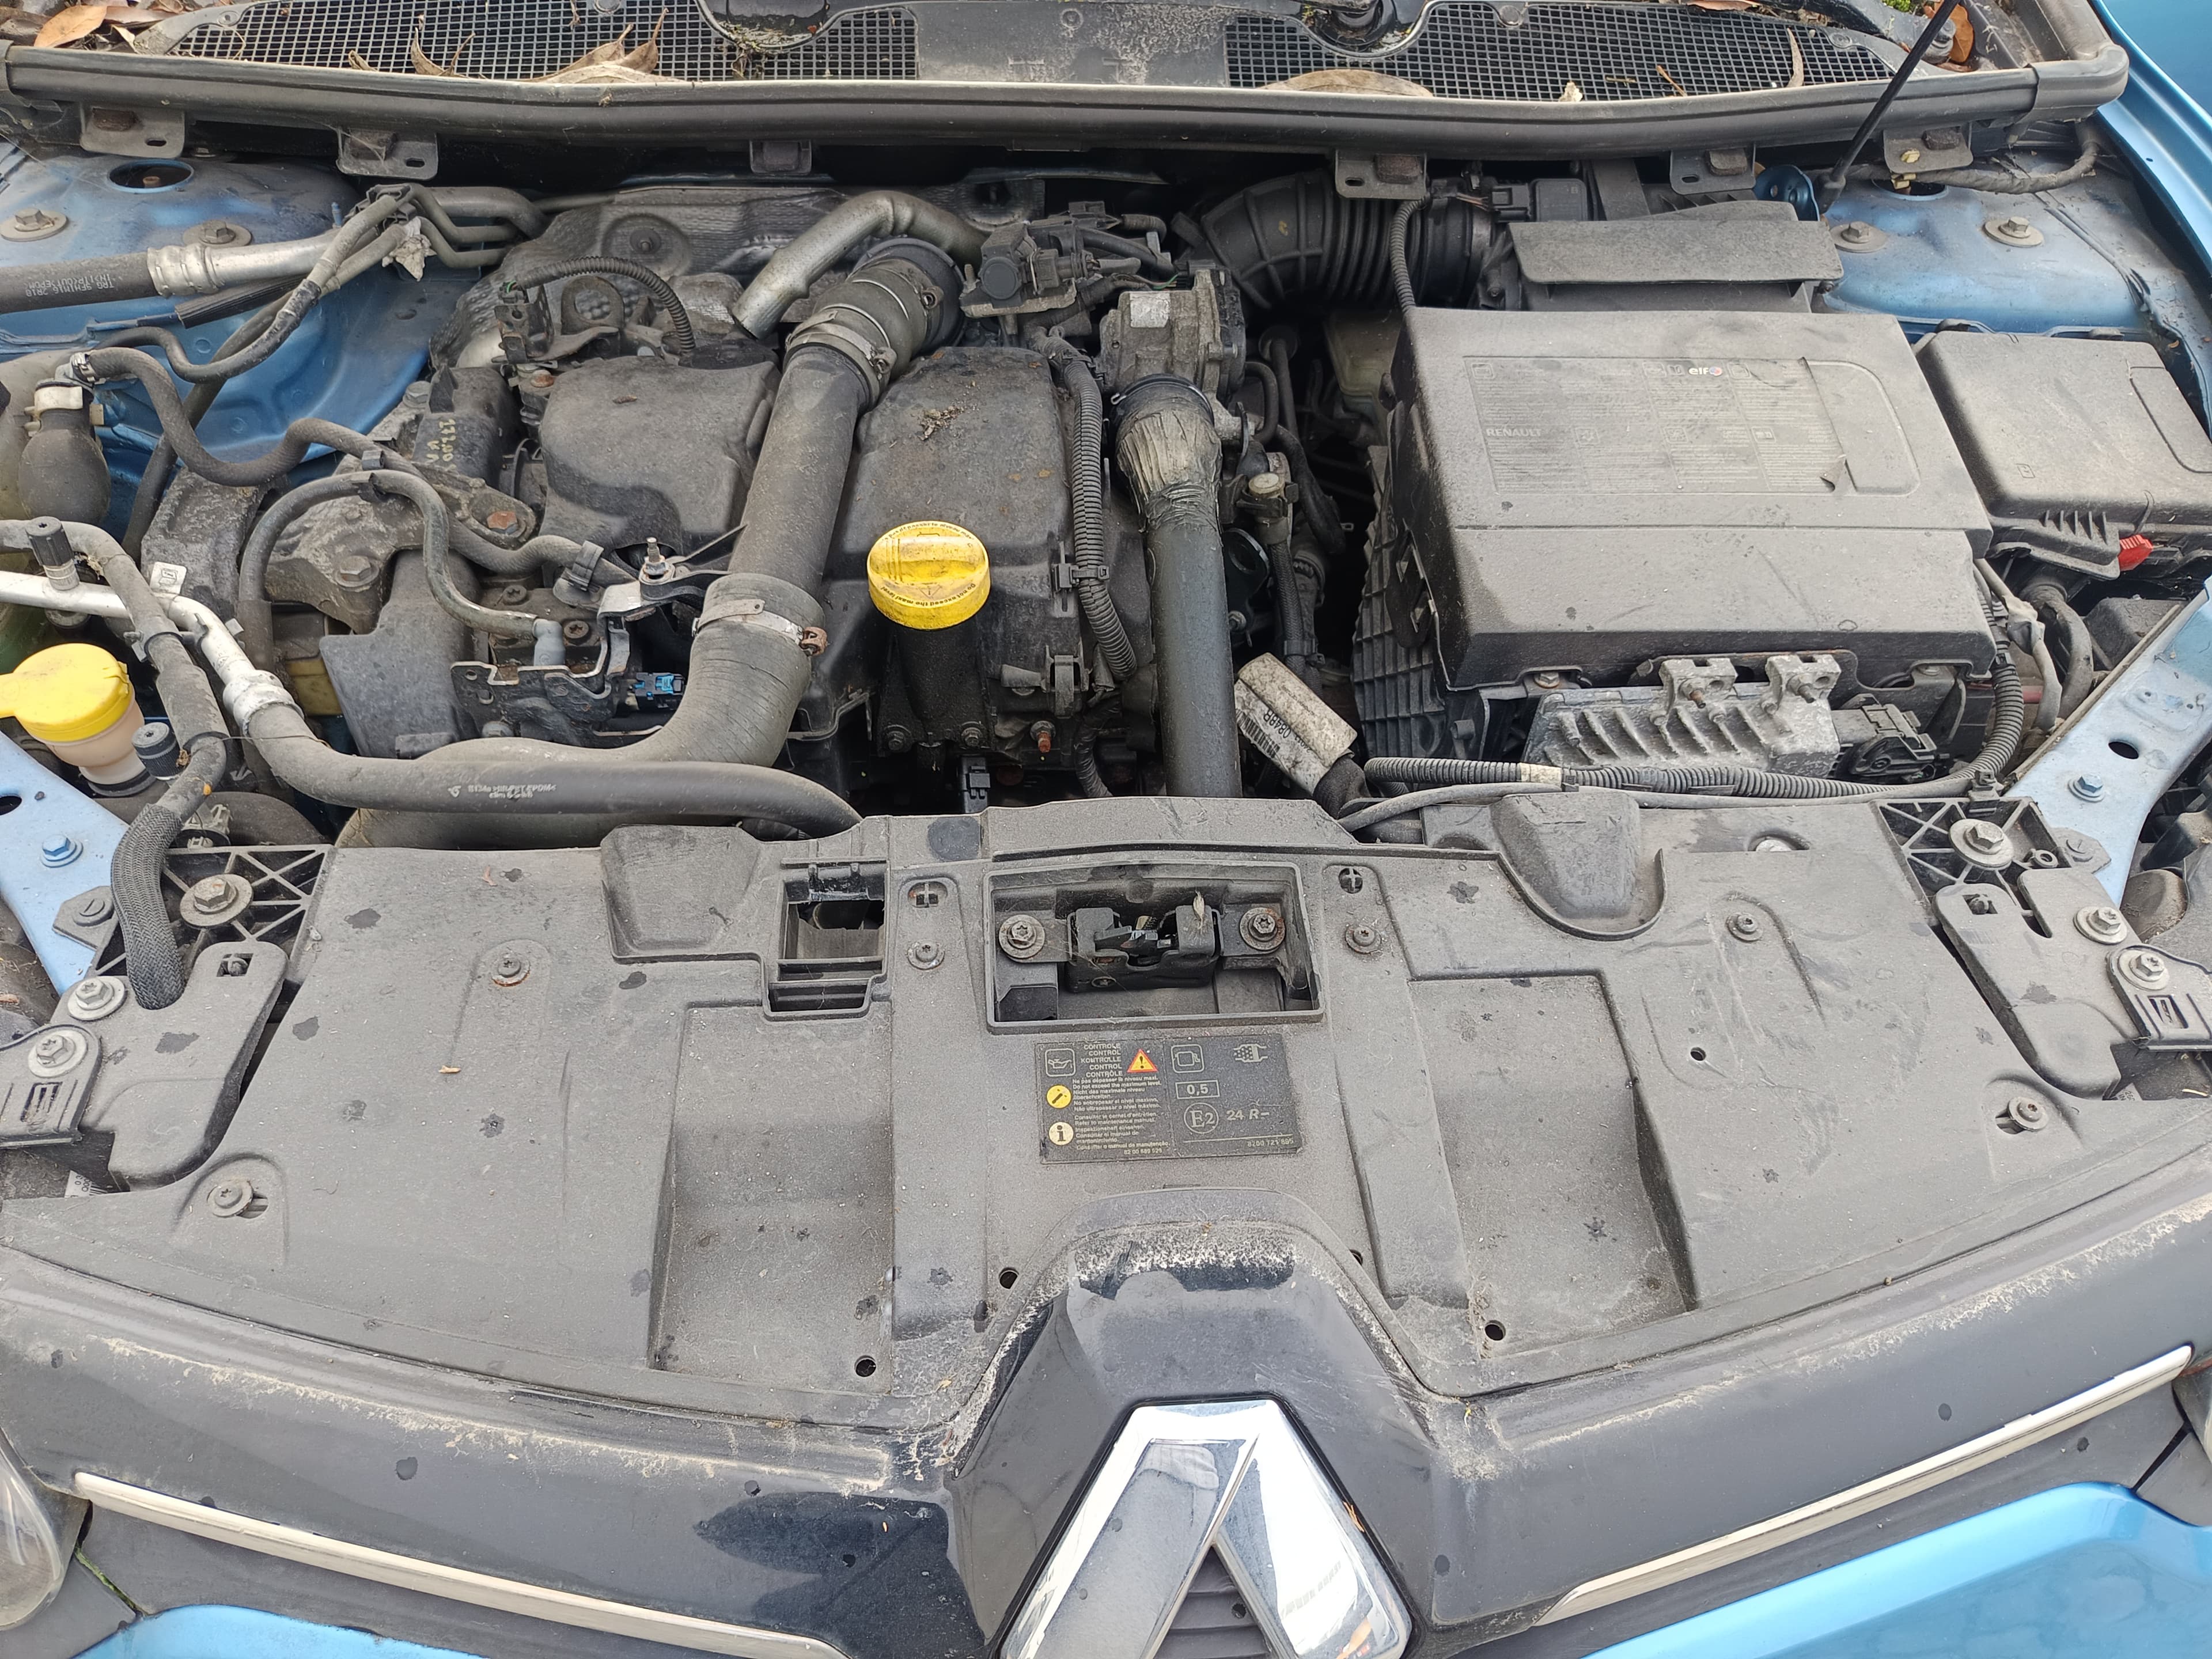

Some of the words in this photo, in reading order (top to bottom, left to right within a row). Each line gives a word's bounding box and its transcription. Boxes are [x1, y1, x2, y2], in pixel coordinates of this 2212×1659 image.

[1688, 367, 1709, 375] elf
[1486, 428, 1542, 437] RENAULT
[880, 586, 896, 599] level
[956, 590, 968, 599] not
[895, 595, 914, 605] maxi
[930, 595, 957, 607] exceed
[1263, 709, 1291, 738] 0848R
[1187, 1084, 1209, 1096] 0,5
[1190, 1110, 1216, 1128] E2
[1226, 1109, 1244, 1121] 24
